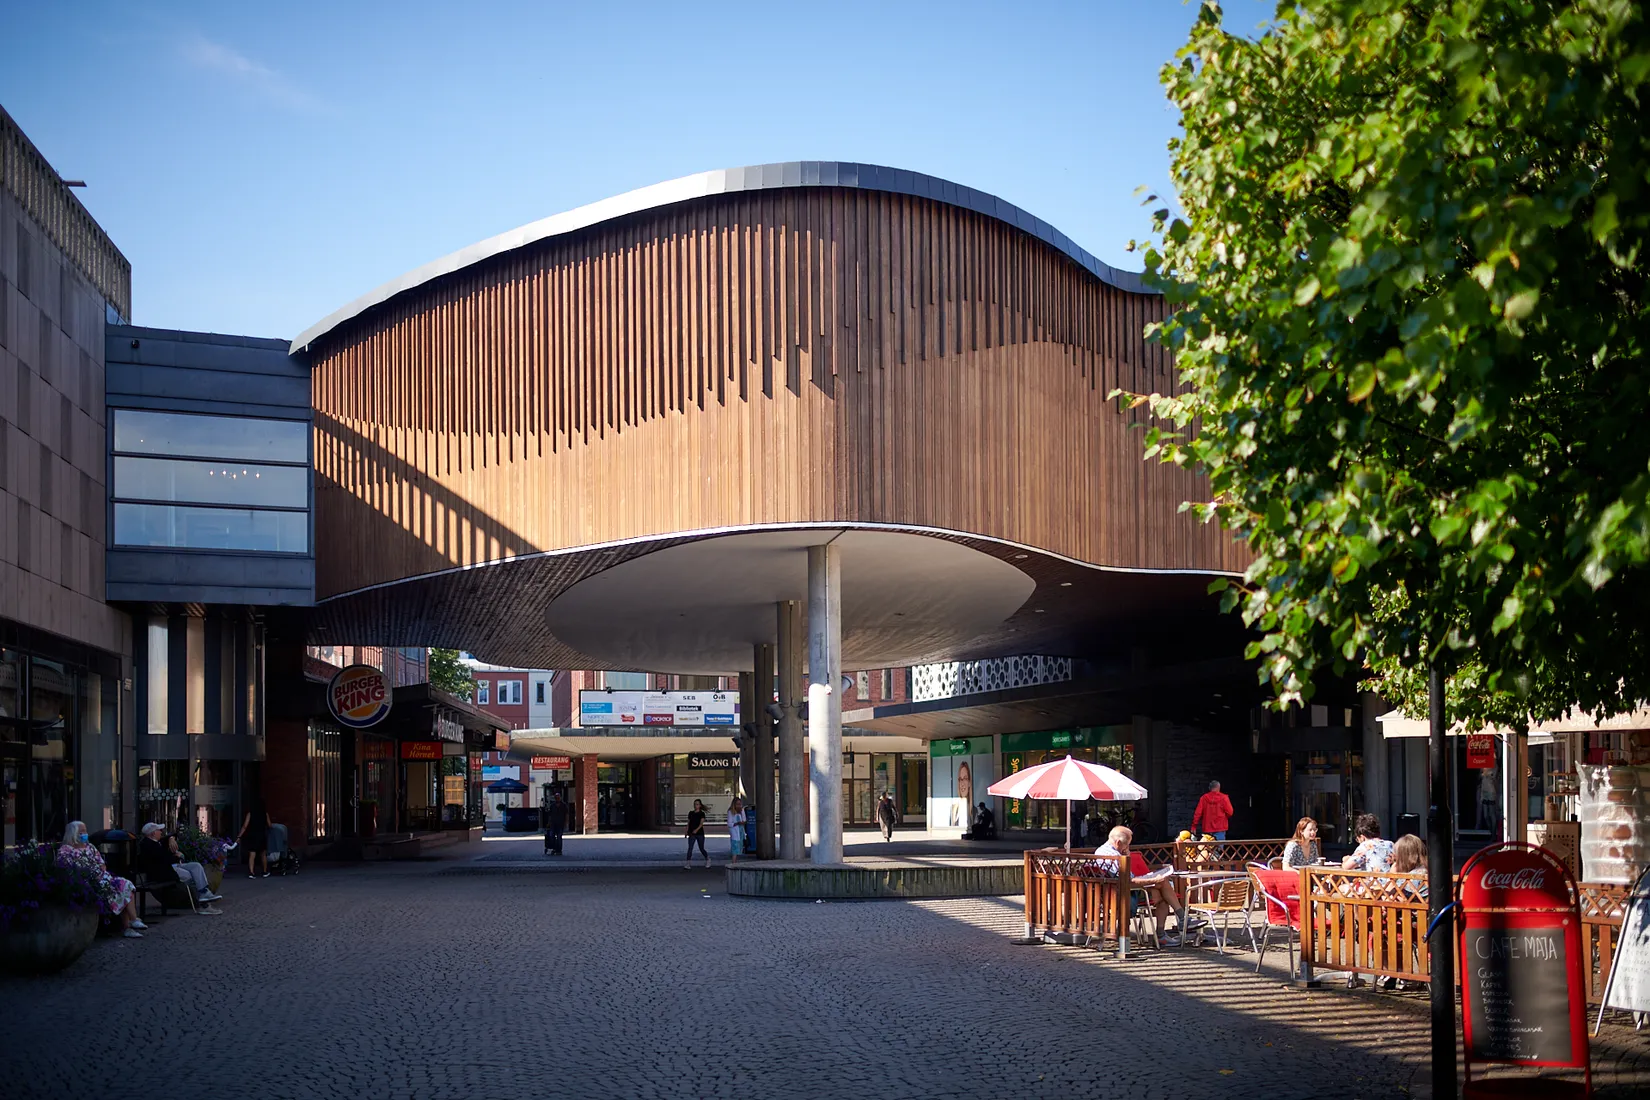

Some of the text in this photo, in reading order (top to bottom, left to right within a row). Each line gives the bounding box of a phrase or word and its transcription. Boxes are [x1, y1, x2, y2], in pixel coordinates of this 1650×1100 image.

[334, 675, 383, 698] BURGER
[337, 685, 385, 714] KING
[1052, 735, 1070, 743] Specsavers
[1468, 738, 1492, 750] Coca-Cola
[412, 743, 432, 751] Kina
[533, 756, 569, 764] RESTAURANG
[691, 757, 729, 767] SALONG
[1480, 868, 1548, 890] Coca-Cola
[1475, 935, 1558, 961] CAFE MAJA
